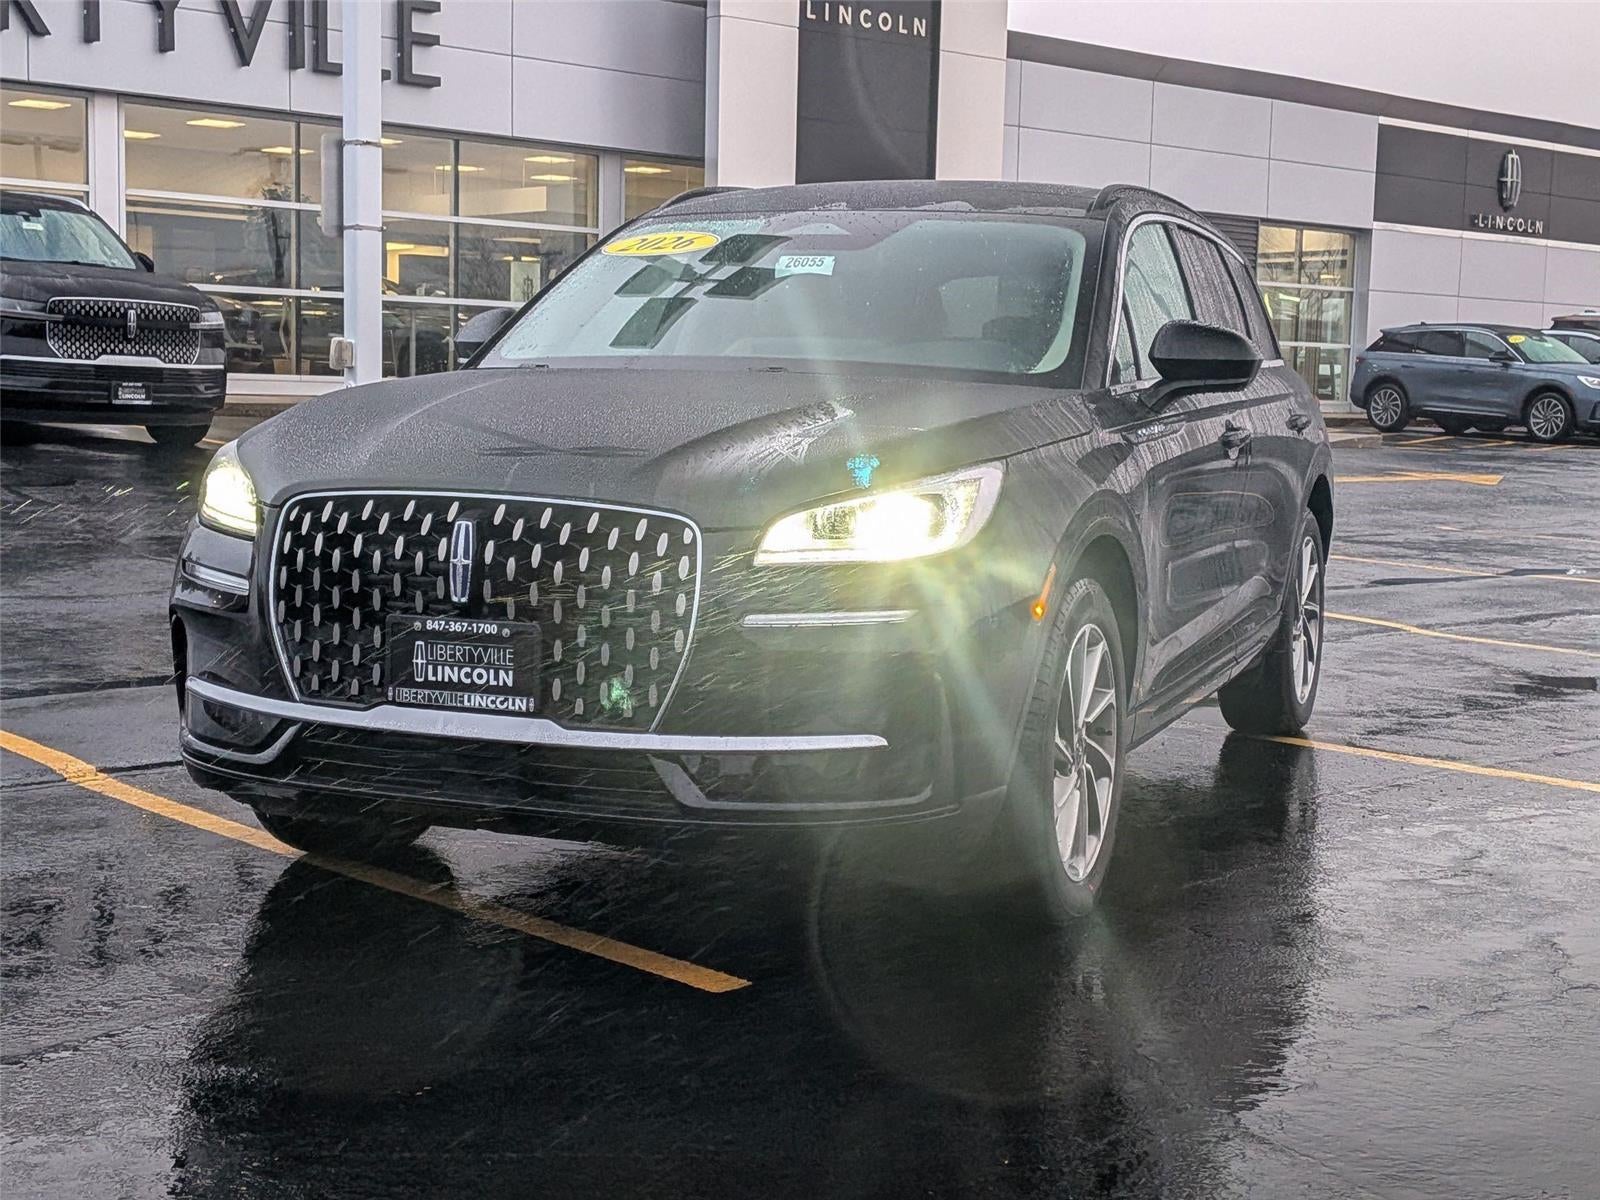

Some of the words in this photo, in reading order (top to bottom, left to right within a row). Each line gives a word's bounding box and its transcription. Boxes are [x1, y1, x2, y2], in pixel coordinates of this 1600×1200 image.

[806, 0, 926, 37] LINCOLN
[1478, 213, 1544, 234] LINCOLN
[615, 235, 705, 252] 2026
[784, 256, 826, 269] 26055
[426, 620, 498, 635] 847-367-1700
[427, 643, 514, 666] LIBERTYVILLE
[427, 665, 513, 687] LINCOLN
